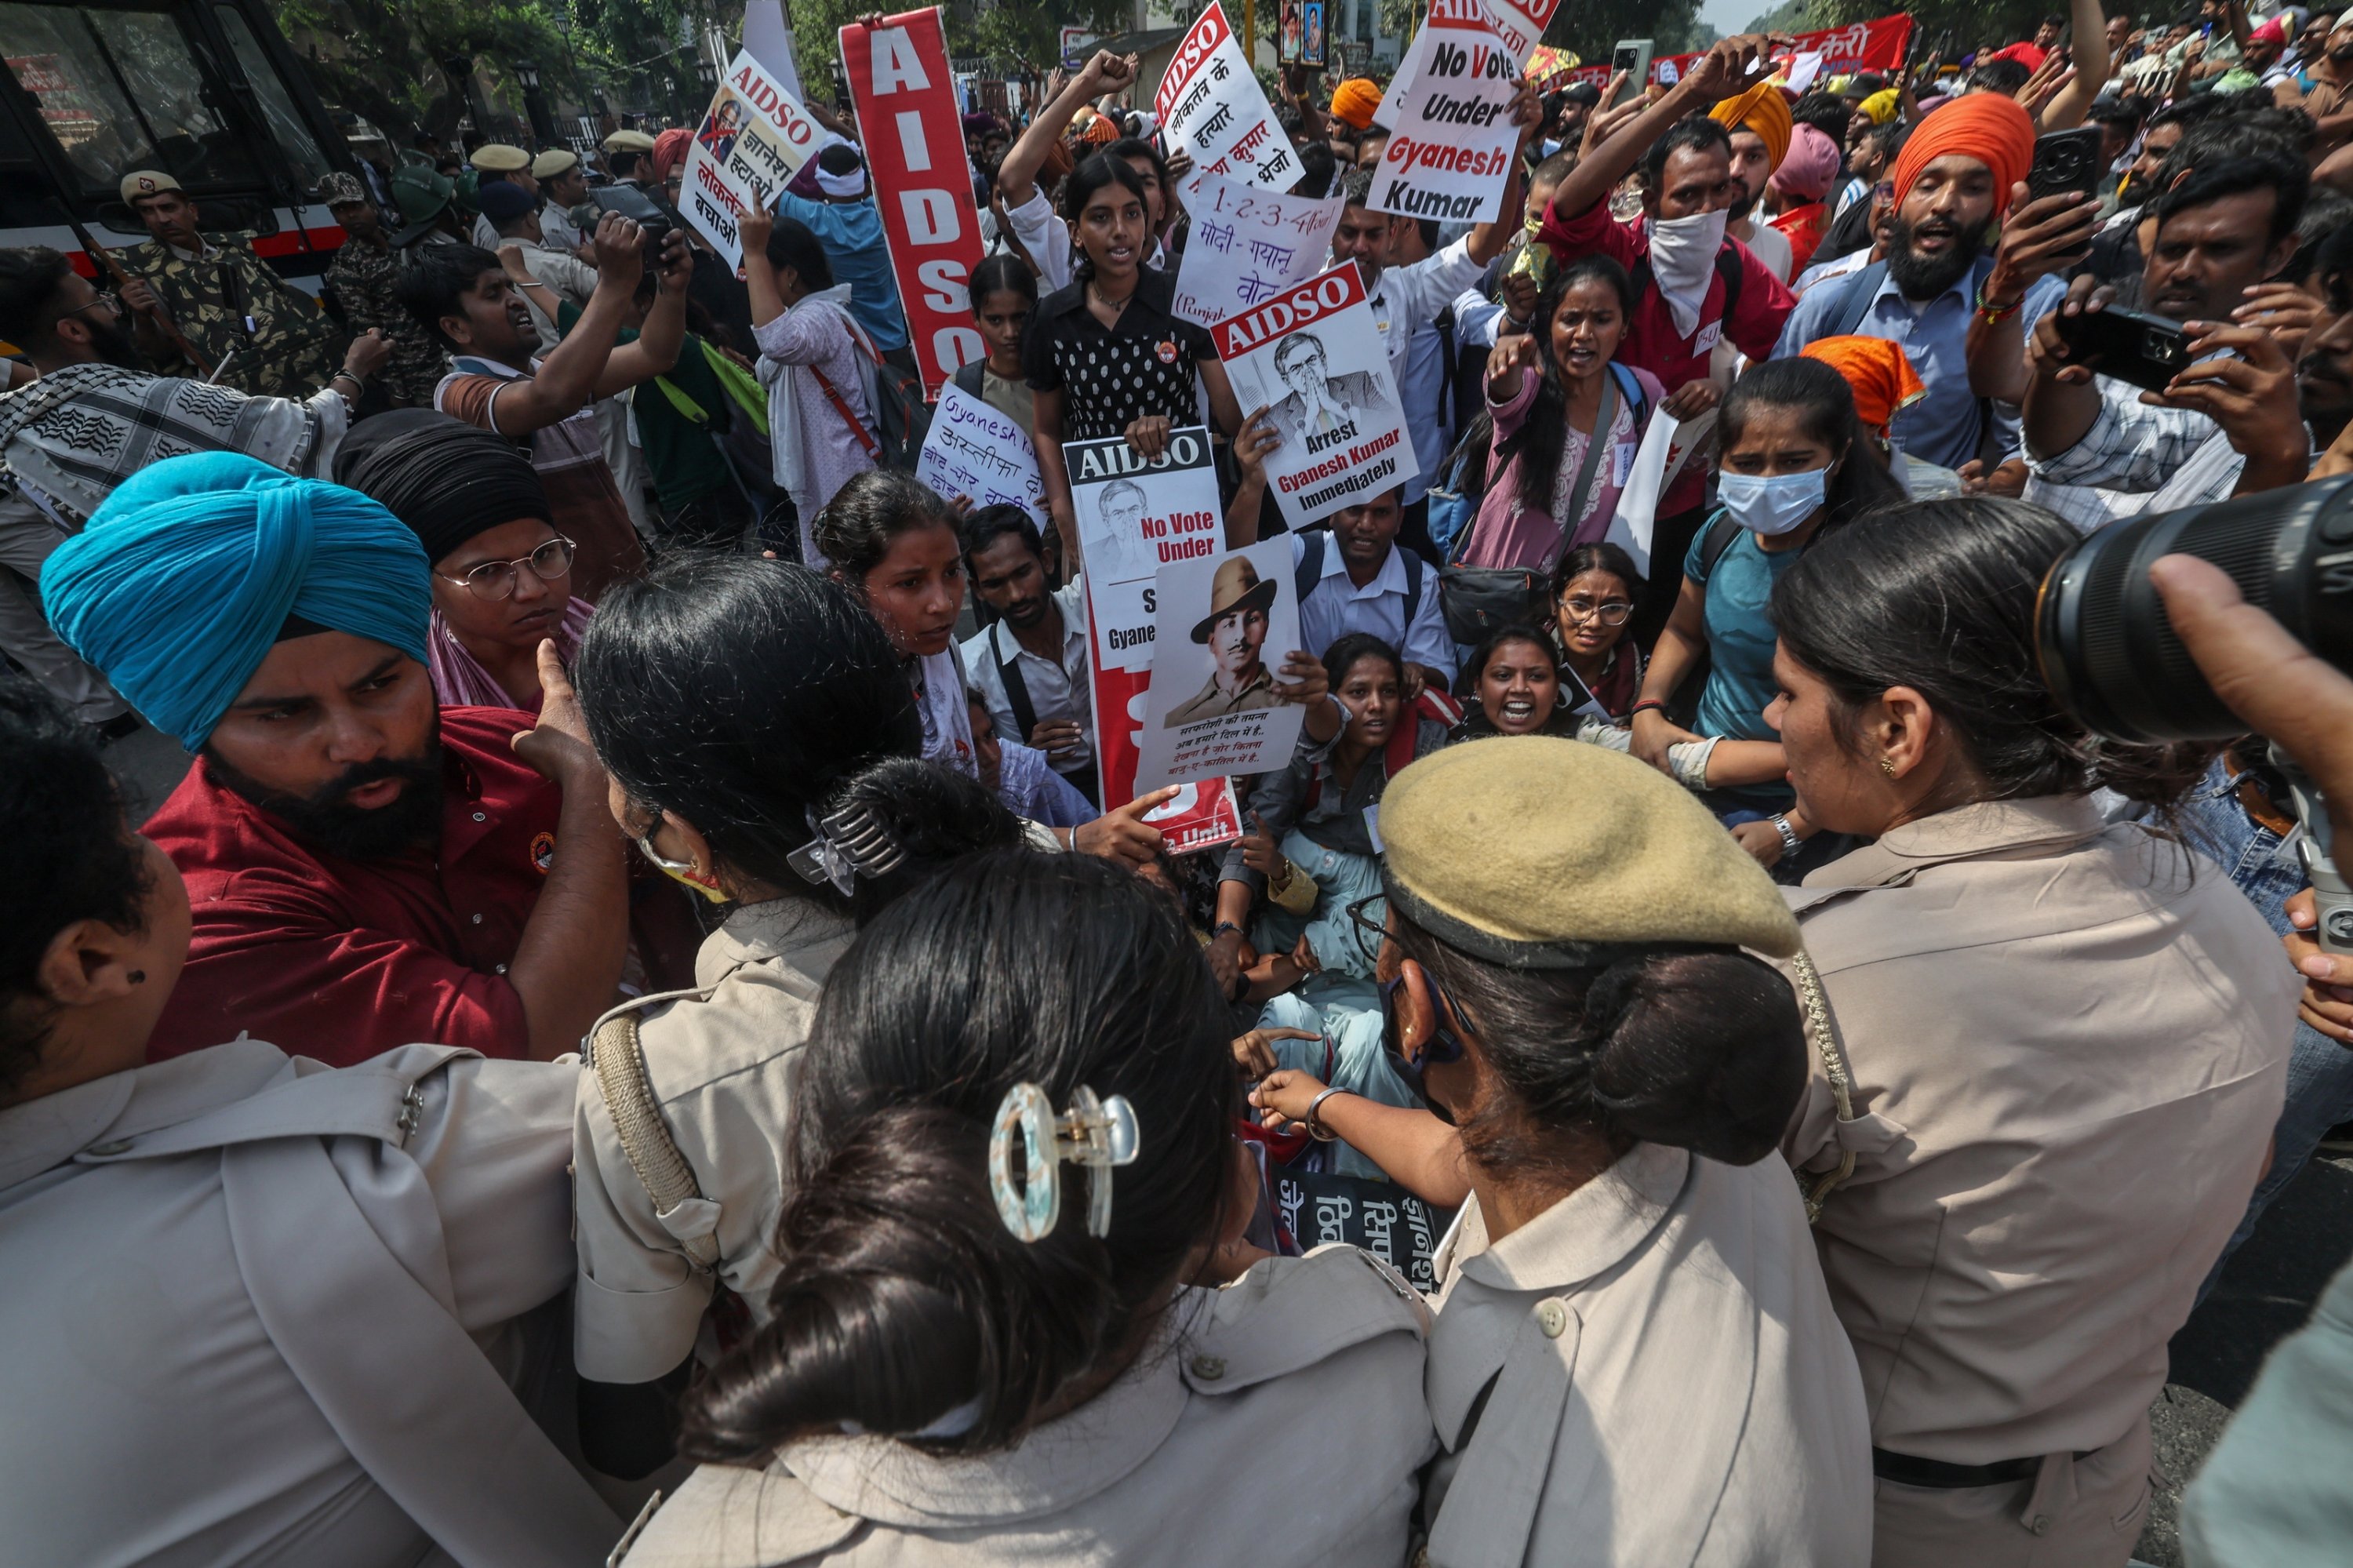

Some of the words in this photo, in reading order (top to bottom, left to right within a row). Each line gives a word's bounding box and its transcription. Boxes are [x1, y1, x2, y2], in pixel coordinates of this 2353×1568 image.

[1159, 18, 1218, 120] AIDSO
[1427, 42, 1467, 78] No
[1471, 44, 1515, 79] Vote
[730, 65, 813, 146] AIDSO
[1171, 78, 1211, 135] लोकतंत्र
[1210, 57, 1230, 82] के
[1422, 93, 1504, 128] Under
[1193, 102, 1235, 149] हत्यारे
[1228, 120, 1271, 164] कुमार
[730, 152, 774, 202] हटाओ
[744, 129, 793, 183] ज्ञानेश
[1257, 148, 1291, 184] भेजो
[1387, 136, 1507, 176] Gyanesh
[695, 191, 737, 249] बचाओ
[870, 25, 987, 376] AIDSO
[1384, 180, 1485, 220] Kumar
[1227, 275, 1351, 355] AIDSO
[945, 395, 1017, 448] Gyanesh
[1305, 419, 1359, 456] Arrest
[1278, 451, 1349, 493] Gyanesh
[1347, 427, 1401, 467] Kumar
[1298, 457, 1397, 511] Immediately
[1140, 518, 1168, 540] No
[1169, 511, 1214, 535] Vote
[1157, 537, 1214, 563] Under
[1108, 624, 1155, 650] Gyane
[1195, 730, 1218, 745] हमारे
[1220, 729, 1240, 740] दिल
[1225, 714, 1239, 725] की
[1232, 740, 1264, 751] कितना
[1182, 820, 1228, 846] Unit
